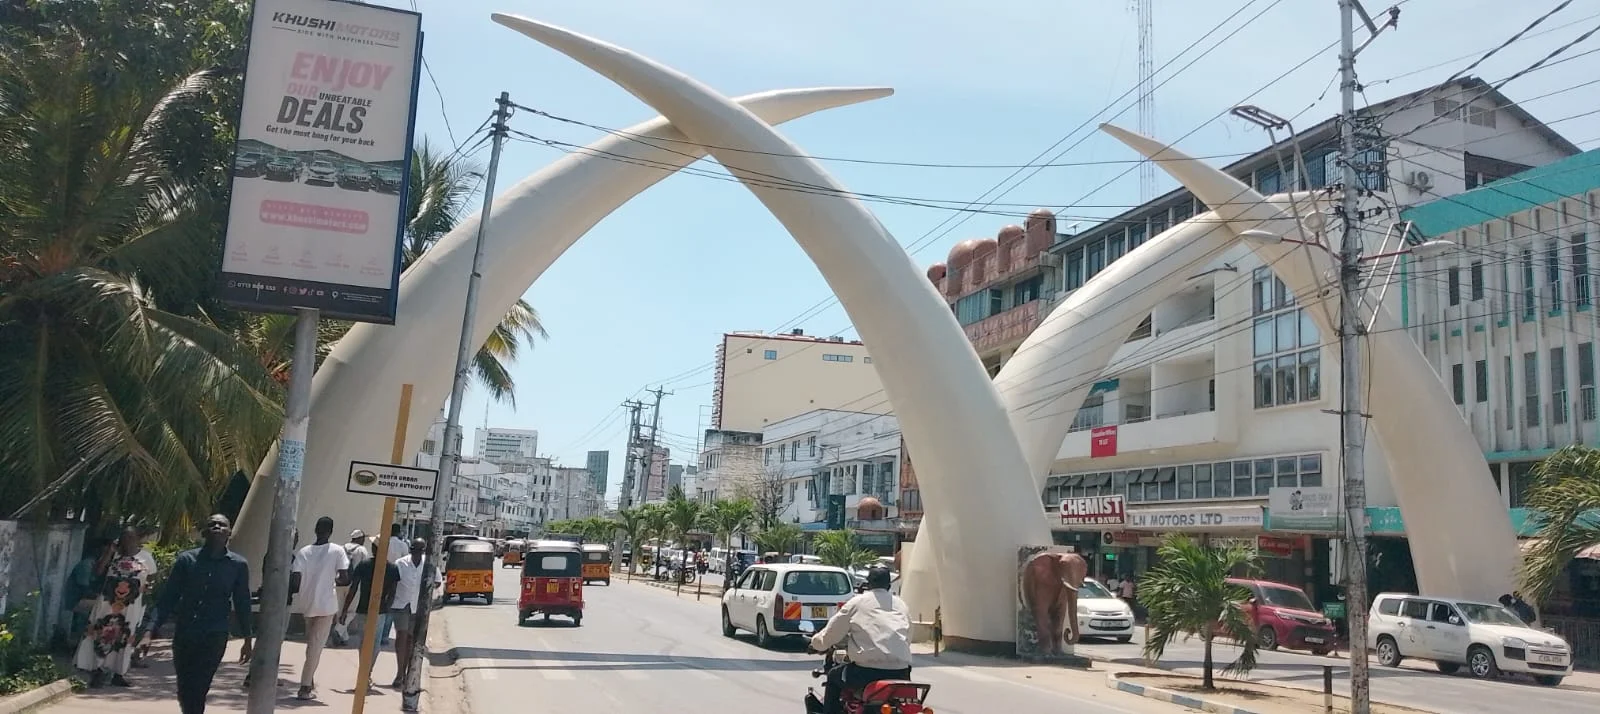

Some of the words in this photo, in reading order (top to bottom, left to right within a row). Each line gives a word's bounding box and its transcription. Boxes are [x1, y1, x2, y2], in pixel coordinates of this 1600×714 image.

[271, 11, 336, 32] KHUSHI
[335, 22, 400, 43] MOTORS
[289, 52, 393, 92] ENJOY
[286, 82, 319, 98] OUR
[319, 92, 373, 108] UNBEATABLE
[276, 95, 367, 135] DEALS
[265, 124, 279, 134] Get
[280, 127, 292, 136] the
[293, 130, 311, 139] most
[329, 133, 342, 142] for
[341, 136, 358, 145] your
[398, 475, 418, 483] URBAN
[399, 483, 432, 492] AUTHORITY
[1060, 497, 1122, 515] CHEMIST
[1132, 515, 1146, 526] LN
[1150, 513, 1195, 526] MOTORS
[1200, 512, 1223, 525] LTD
